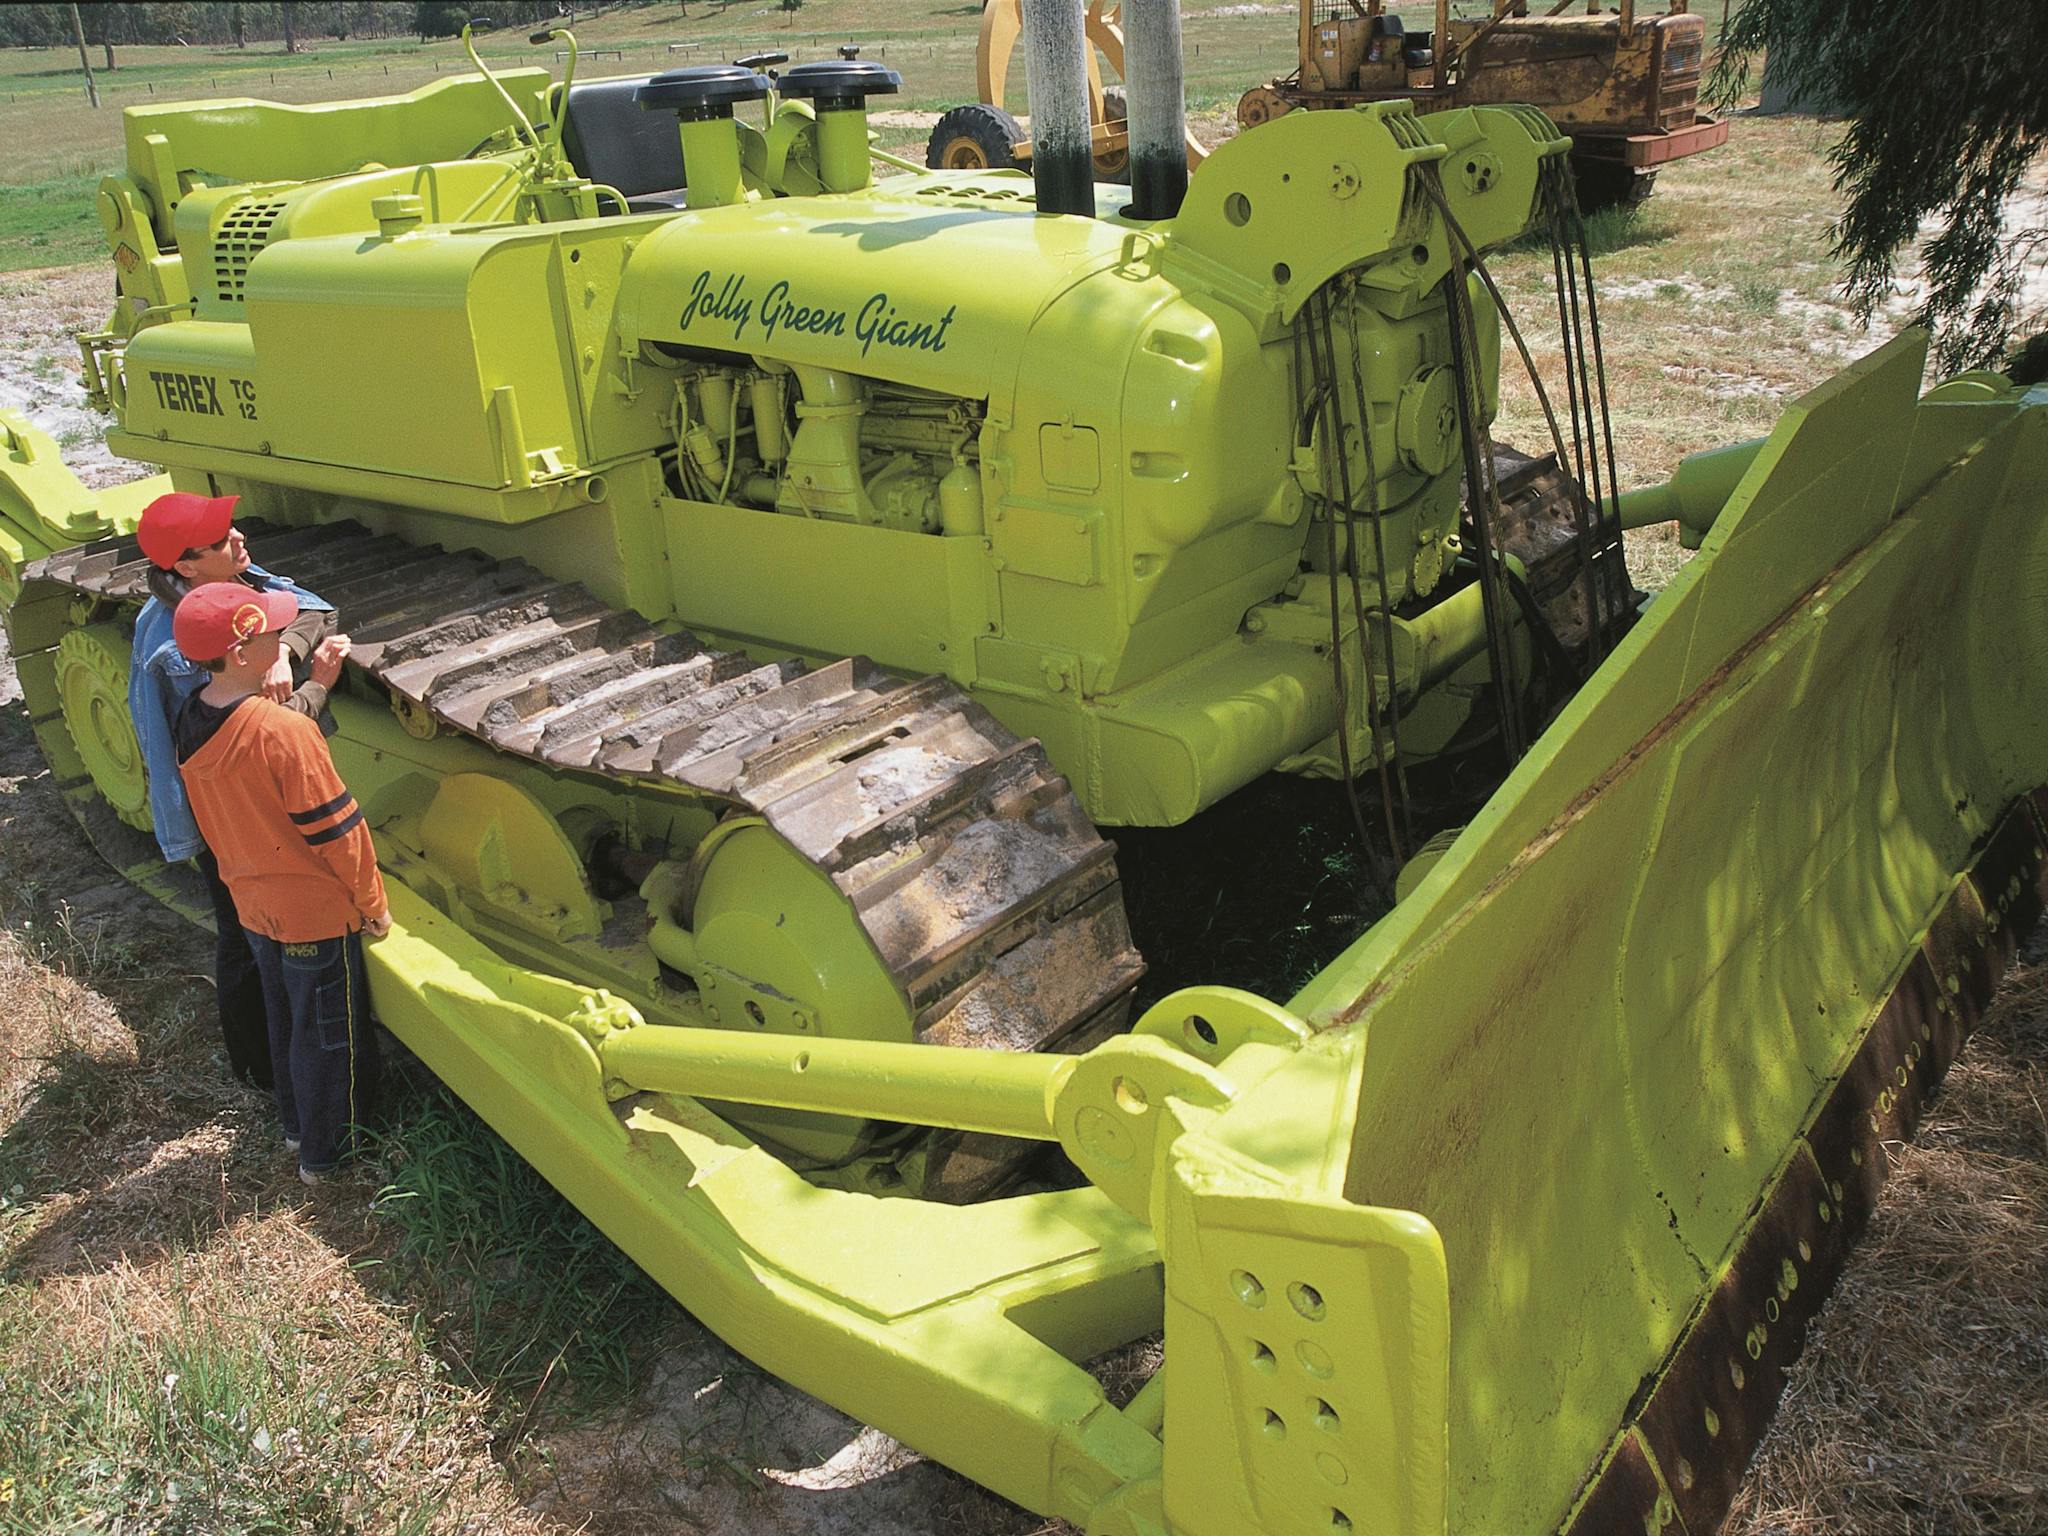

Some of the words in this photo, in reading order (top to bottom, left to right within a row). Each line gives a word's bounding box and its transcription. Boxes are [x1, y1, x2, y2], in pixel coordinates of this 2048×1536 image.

[680, 270, 752, 341] Jolly
[760, 280, 846, 343] Green
[855, 293, 956, 358] Giant
[149, 371, 225, 416] TEREX
[229, 379, 257, 401] TC
[239, 402, 258, 420] 12
